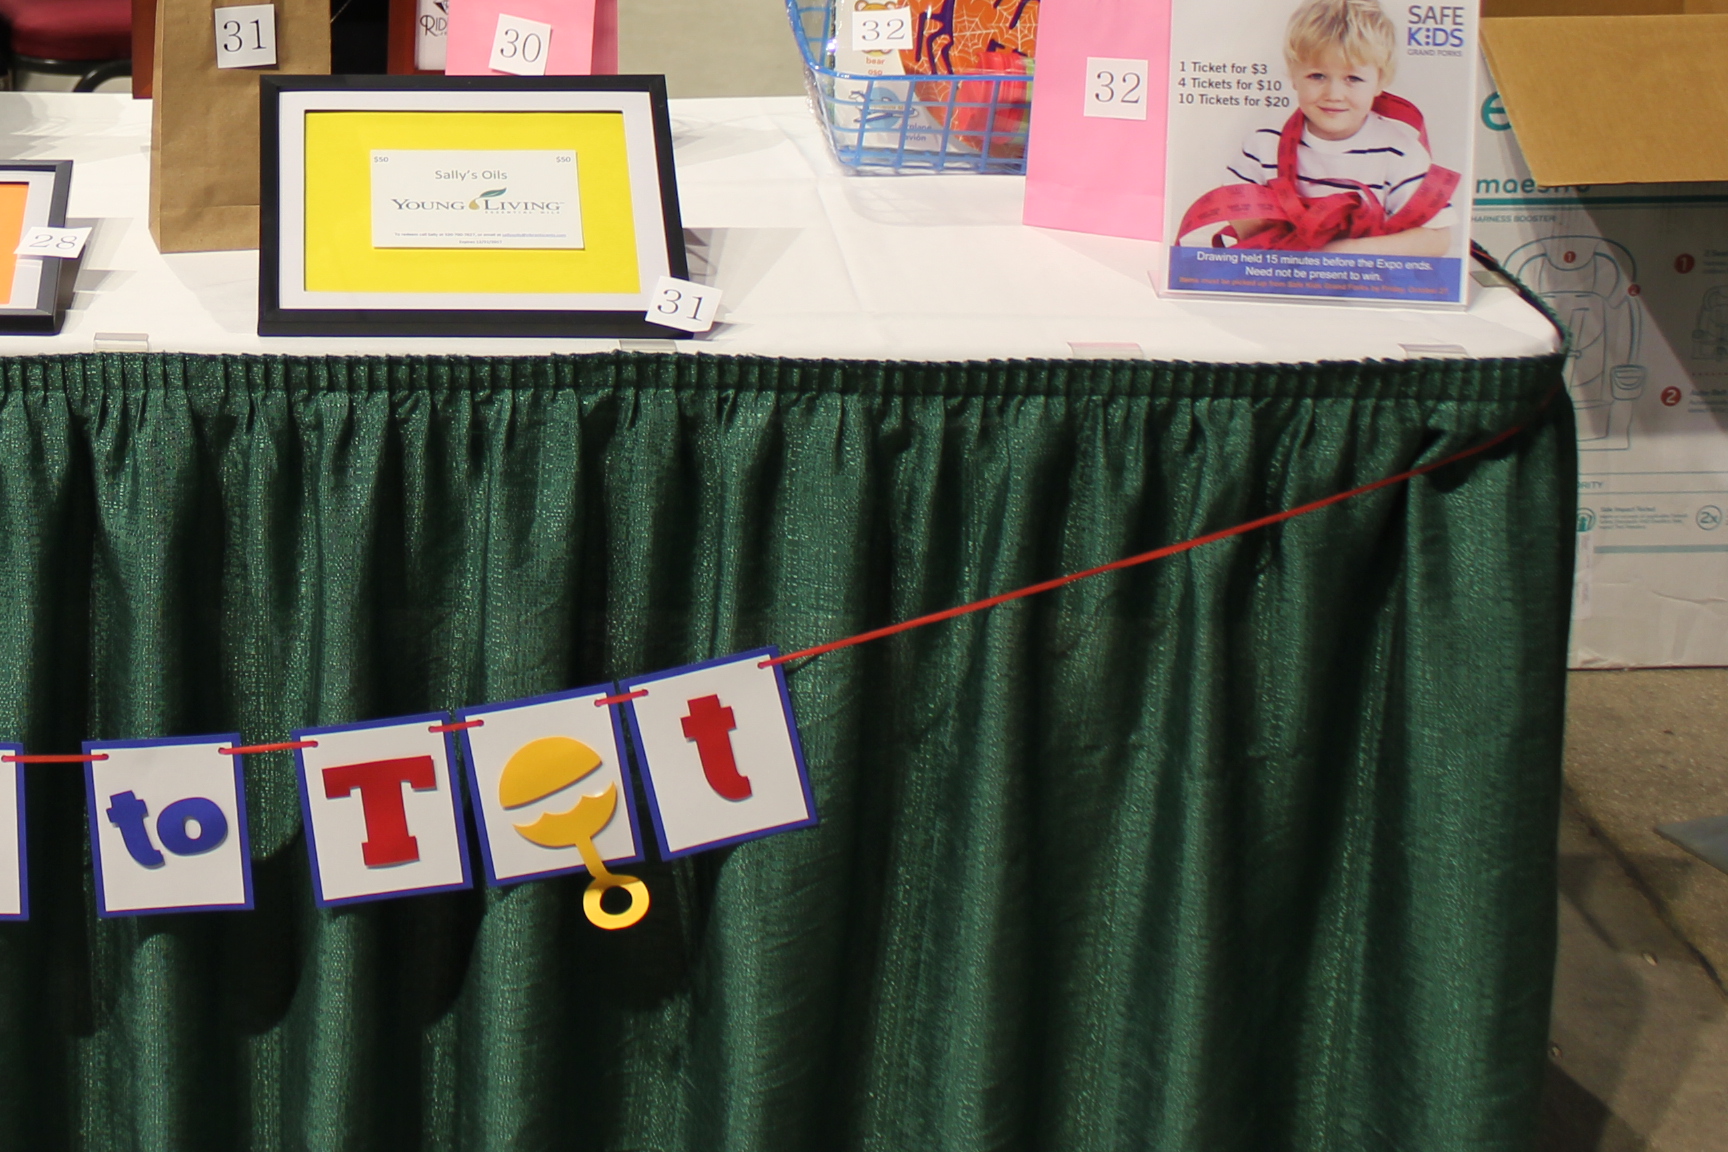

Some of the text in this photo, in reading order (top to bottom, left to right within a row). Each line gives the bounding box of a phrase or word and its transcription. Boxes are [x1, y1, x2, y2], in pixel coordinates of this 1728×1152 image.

[1407, 4, 1466, 25] SAFE
[222, 19, 268, 53] 31
[861, 18, 907, 42] 32
[499, 28, 543, 63] 30
[865, 56, 885, 65] bear
[1180, 61, 1268, 76] 1 Ticket for $3
[1094, 70, 1141, 104] 32
[1178, 77, 1282, 91] 4 Tickets for $10
[1178, 93, 1290, 108] 10 Tickets for $20
[374, 156, 389, 164] $50
[556, 156, 571, 164] $50
[481, 170, 508, 181] Oils
[391, 198, 561, 211] YOUNG LIVING
[1471, 214, 1557, 223] HARNESS BOOSTER
[29, 233, 78, 252] 28
[1197, 250, 1434, 271] Drawing held 15 minutes before the Expo ends.
[1245, 266, 1383, 283] Need not be present to win.
[657, 288, 704, 322] 31
[105, 790, 229, 869] to
